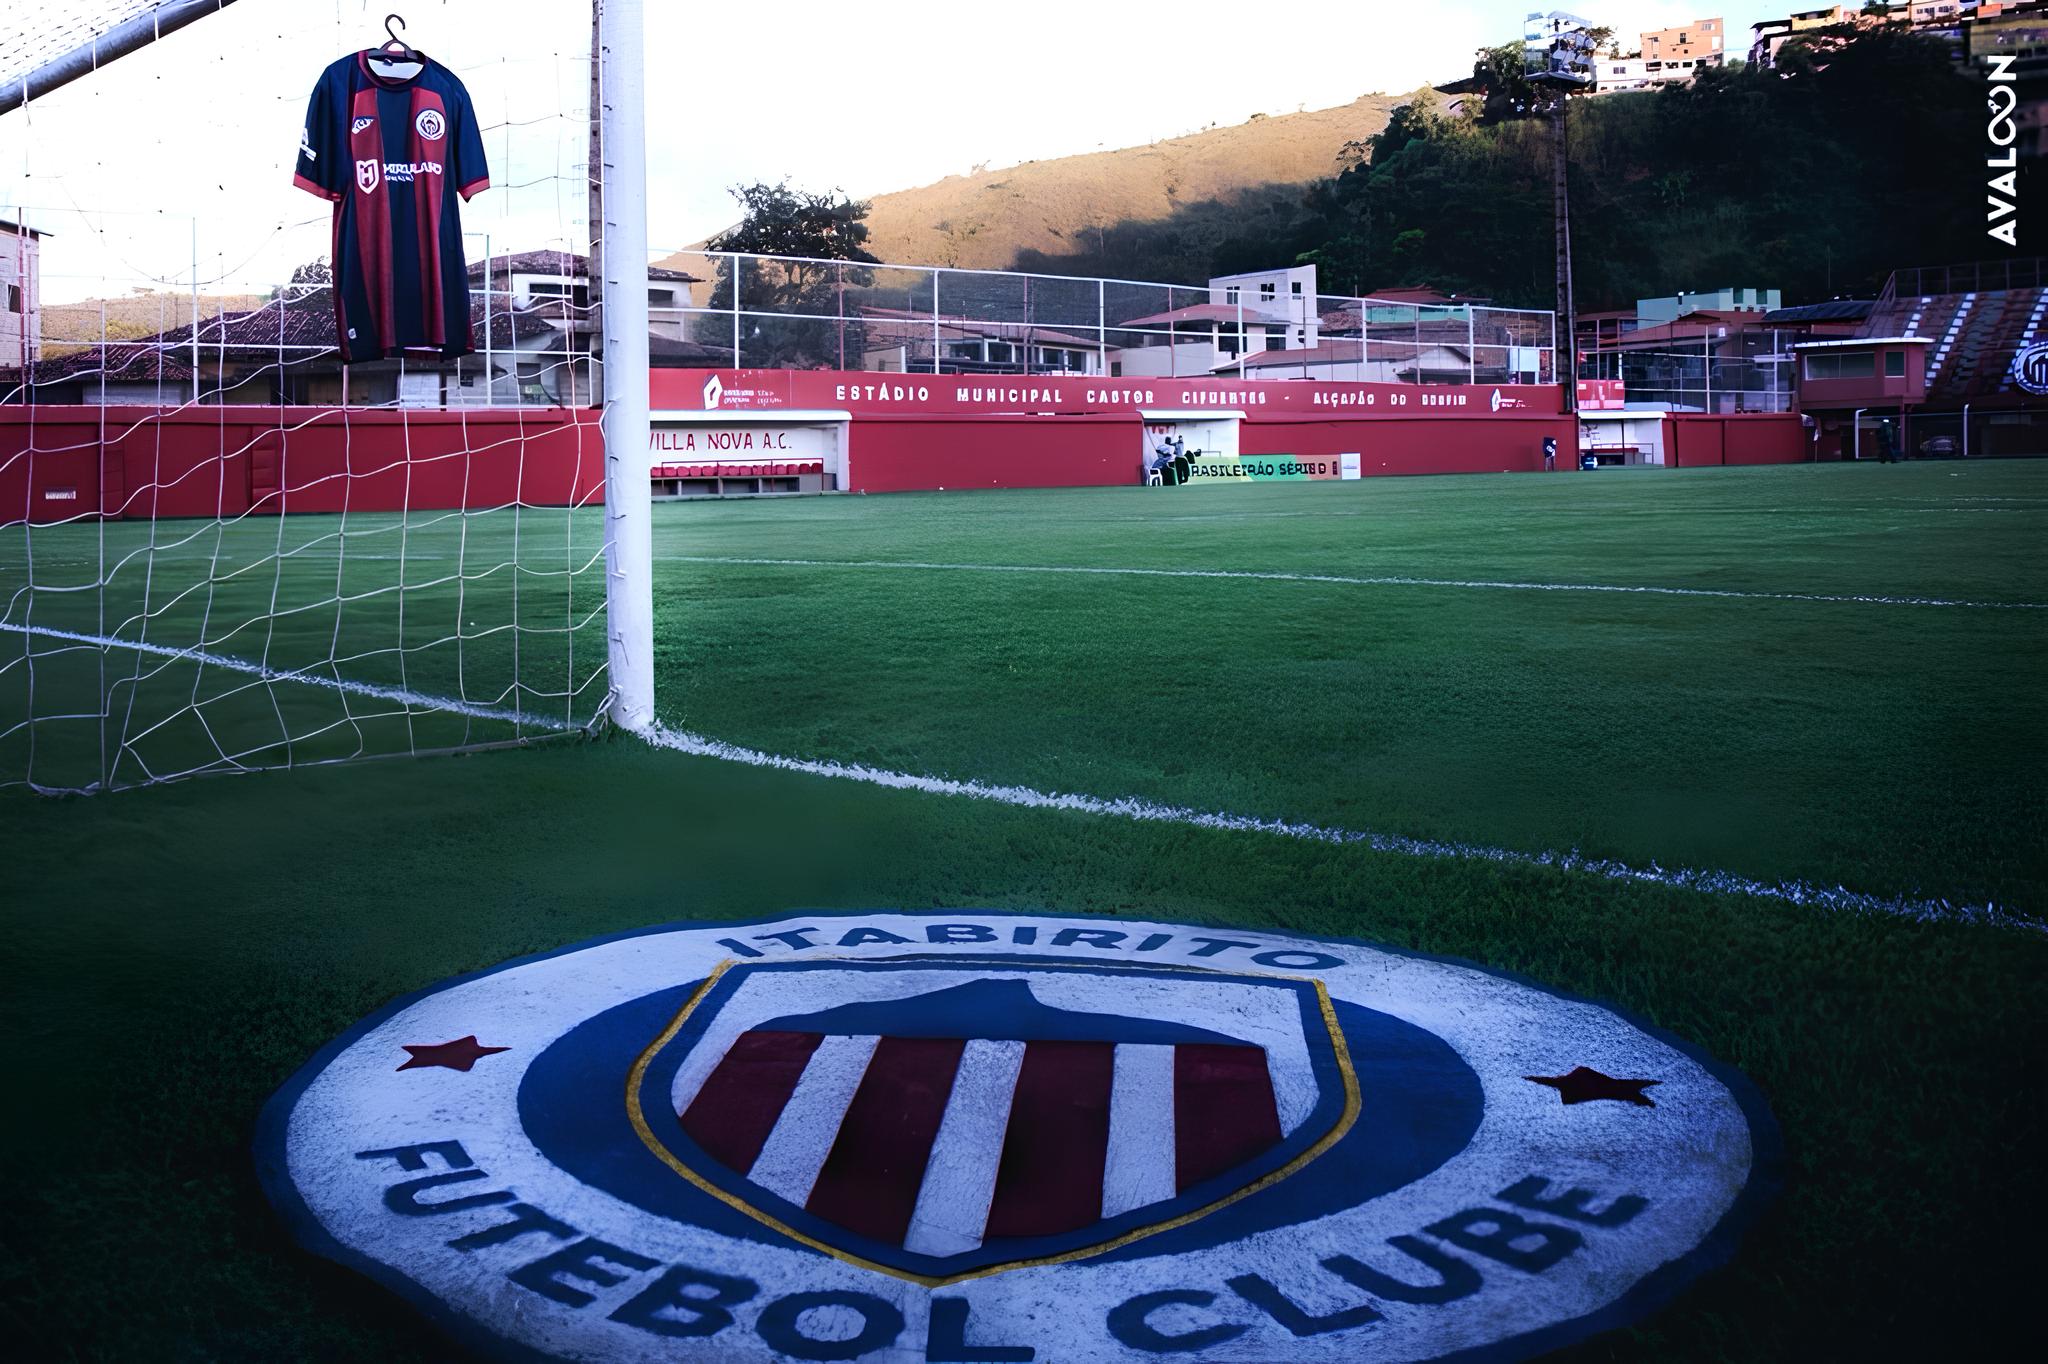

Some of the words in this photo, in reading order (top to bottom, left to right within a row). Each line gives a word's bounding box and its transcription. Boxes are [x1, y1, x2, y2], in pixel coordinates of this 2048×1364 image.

[836, 382, 929, 401] ESTÁDIO
[956, 387, 1063, 403] MUNICIPAL
[1086, 390, 1154, 404] CASTOR
[707, 432, 753, 450] NOVA
[763, 432, 793, 450] A.C.
[1191, 461, 1274, 477] RASILEIRÃO
[717, 922, 1346, 969] ITABIRITO
[355, 1139, 1035, 1363] FUTEBOL
[1105, 1174, 1652, 1354] CLUBE
